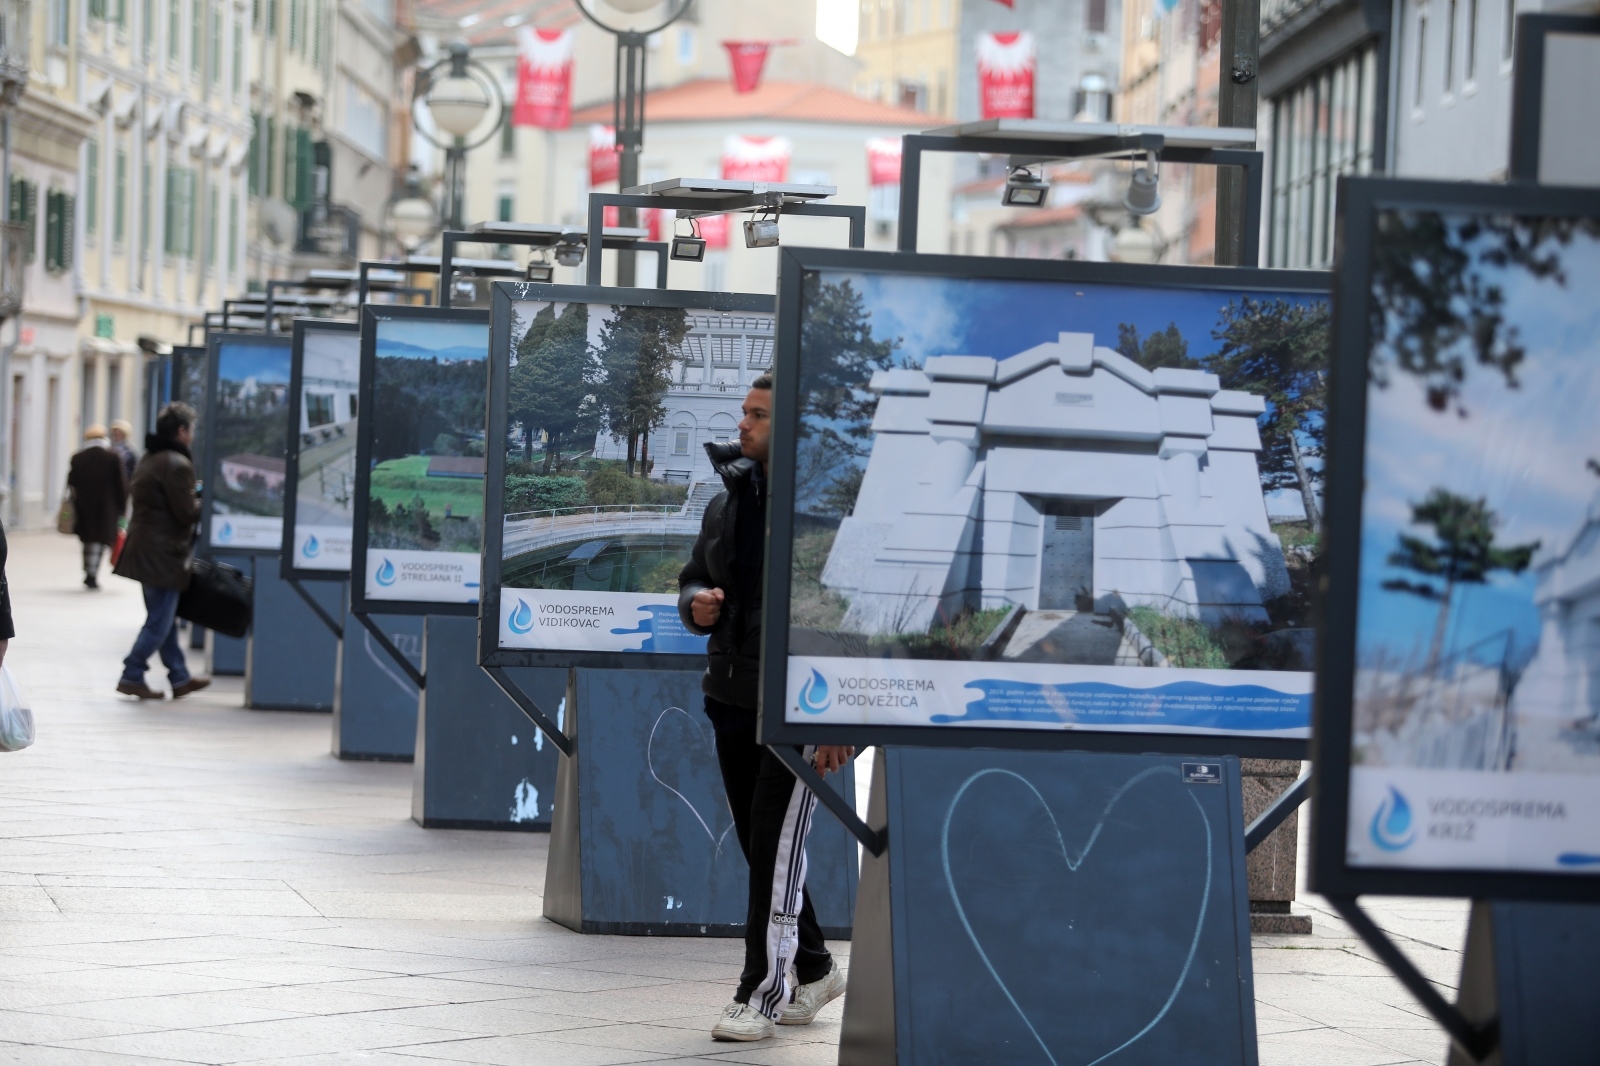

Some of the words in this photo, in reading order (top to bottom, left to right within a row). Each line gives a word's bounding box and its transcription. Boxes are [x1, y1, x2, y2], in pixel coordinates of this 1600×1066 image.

[401, 562, 464, 572] VODOSPREMA
[401, 572, 452, 582] STRELJANA
[540, 604, 614, 616] VODOSPREMA
[538, 618, 600, 628] VIDIKOVAC
[838, 678, 935, 691] VODOSPREMA
[838, 692, 918, 707] PODVEŽICA
[1427, 798, 1566, 820] VODOSPREMA
[1427, 820, 1476, 841] KRIŽ
[774, 915, 796, 924] adidas
